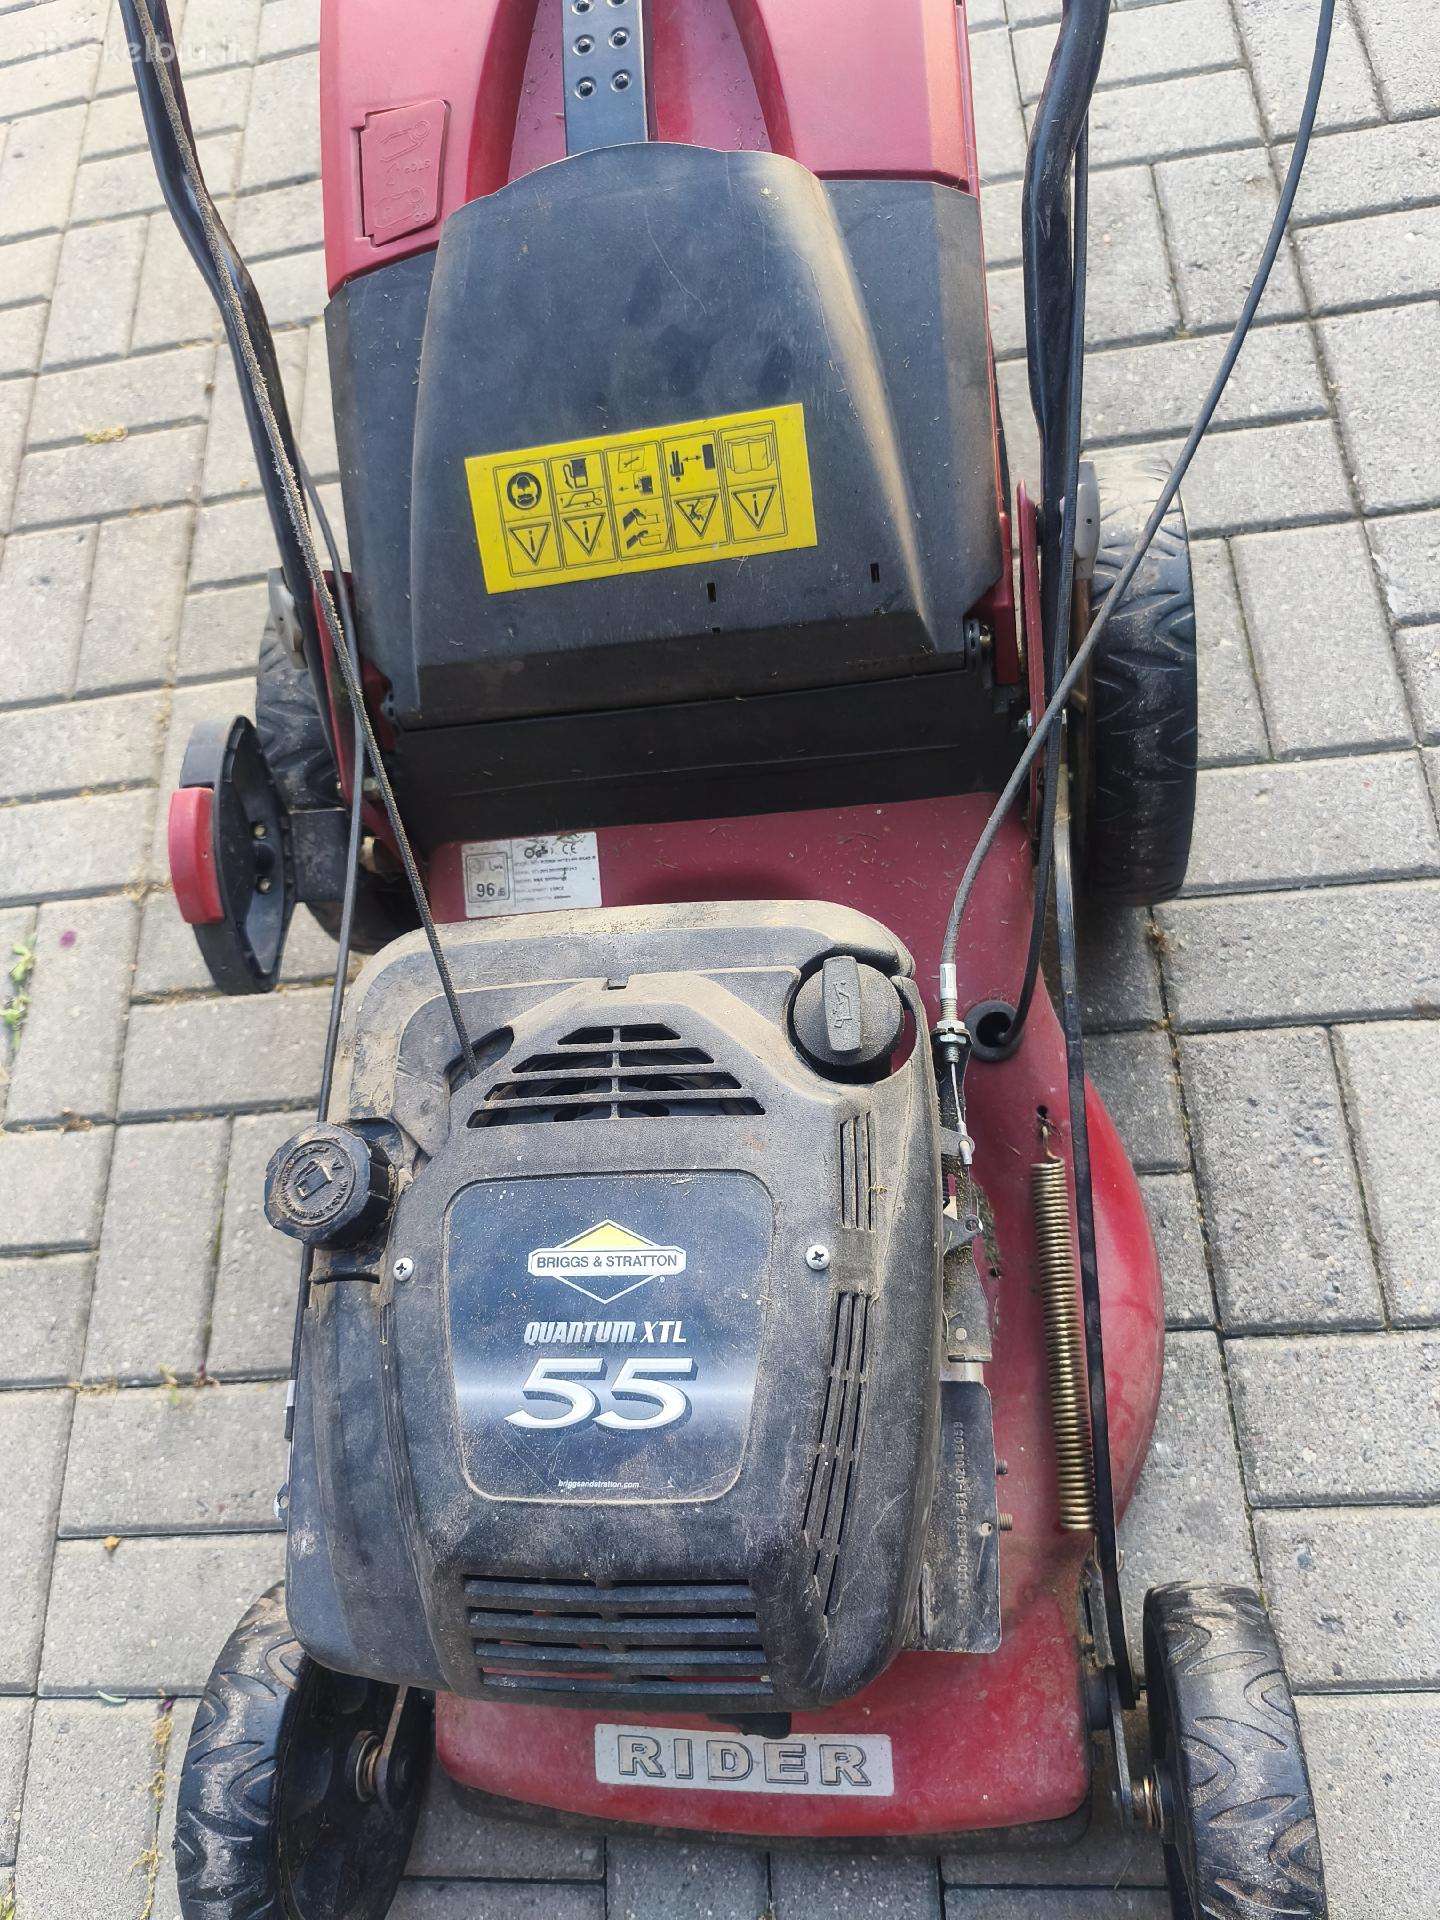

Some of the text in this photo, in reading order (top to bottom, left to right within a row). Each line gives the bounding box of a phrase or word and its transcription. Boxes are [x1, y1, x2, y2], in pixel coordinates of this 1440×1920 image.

[476, 882, 496, 898] 96
[536, 1253, 678, 1269] BRIGGS & STRATTON
[523, 1320, 687, 1344] QUANTUM XTL
[503, 1356, 700, 1430] 55
[557, 1479, 640, 1489] briggsandstratton.com
[616, 1733, 872, 1787] RIDER
